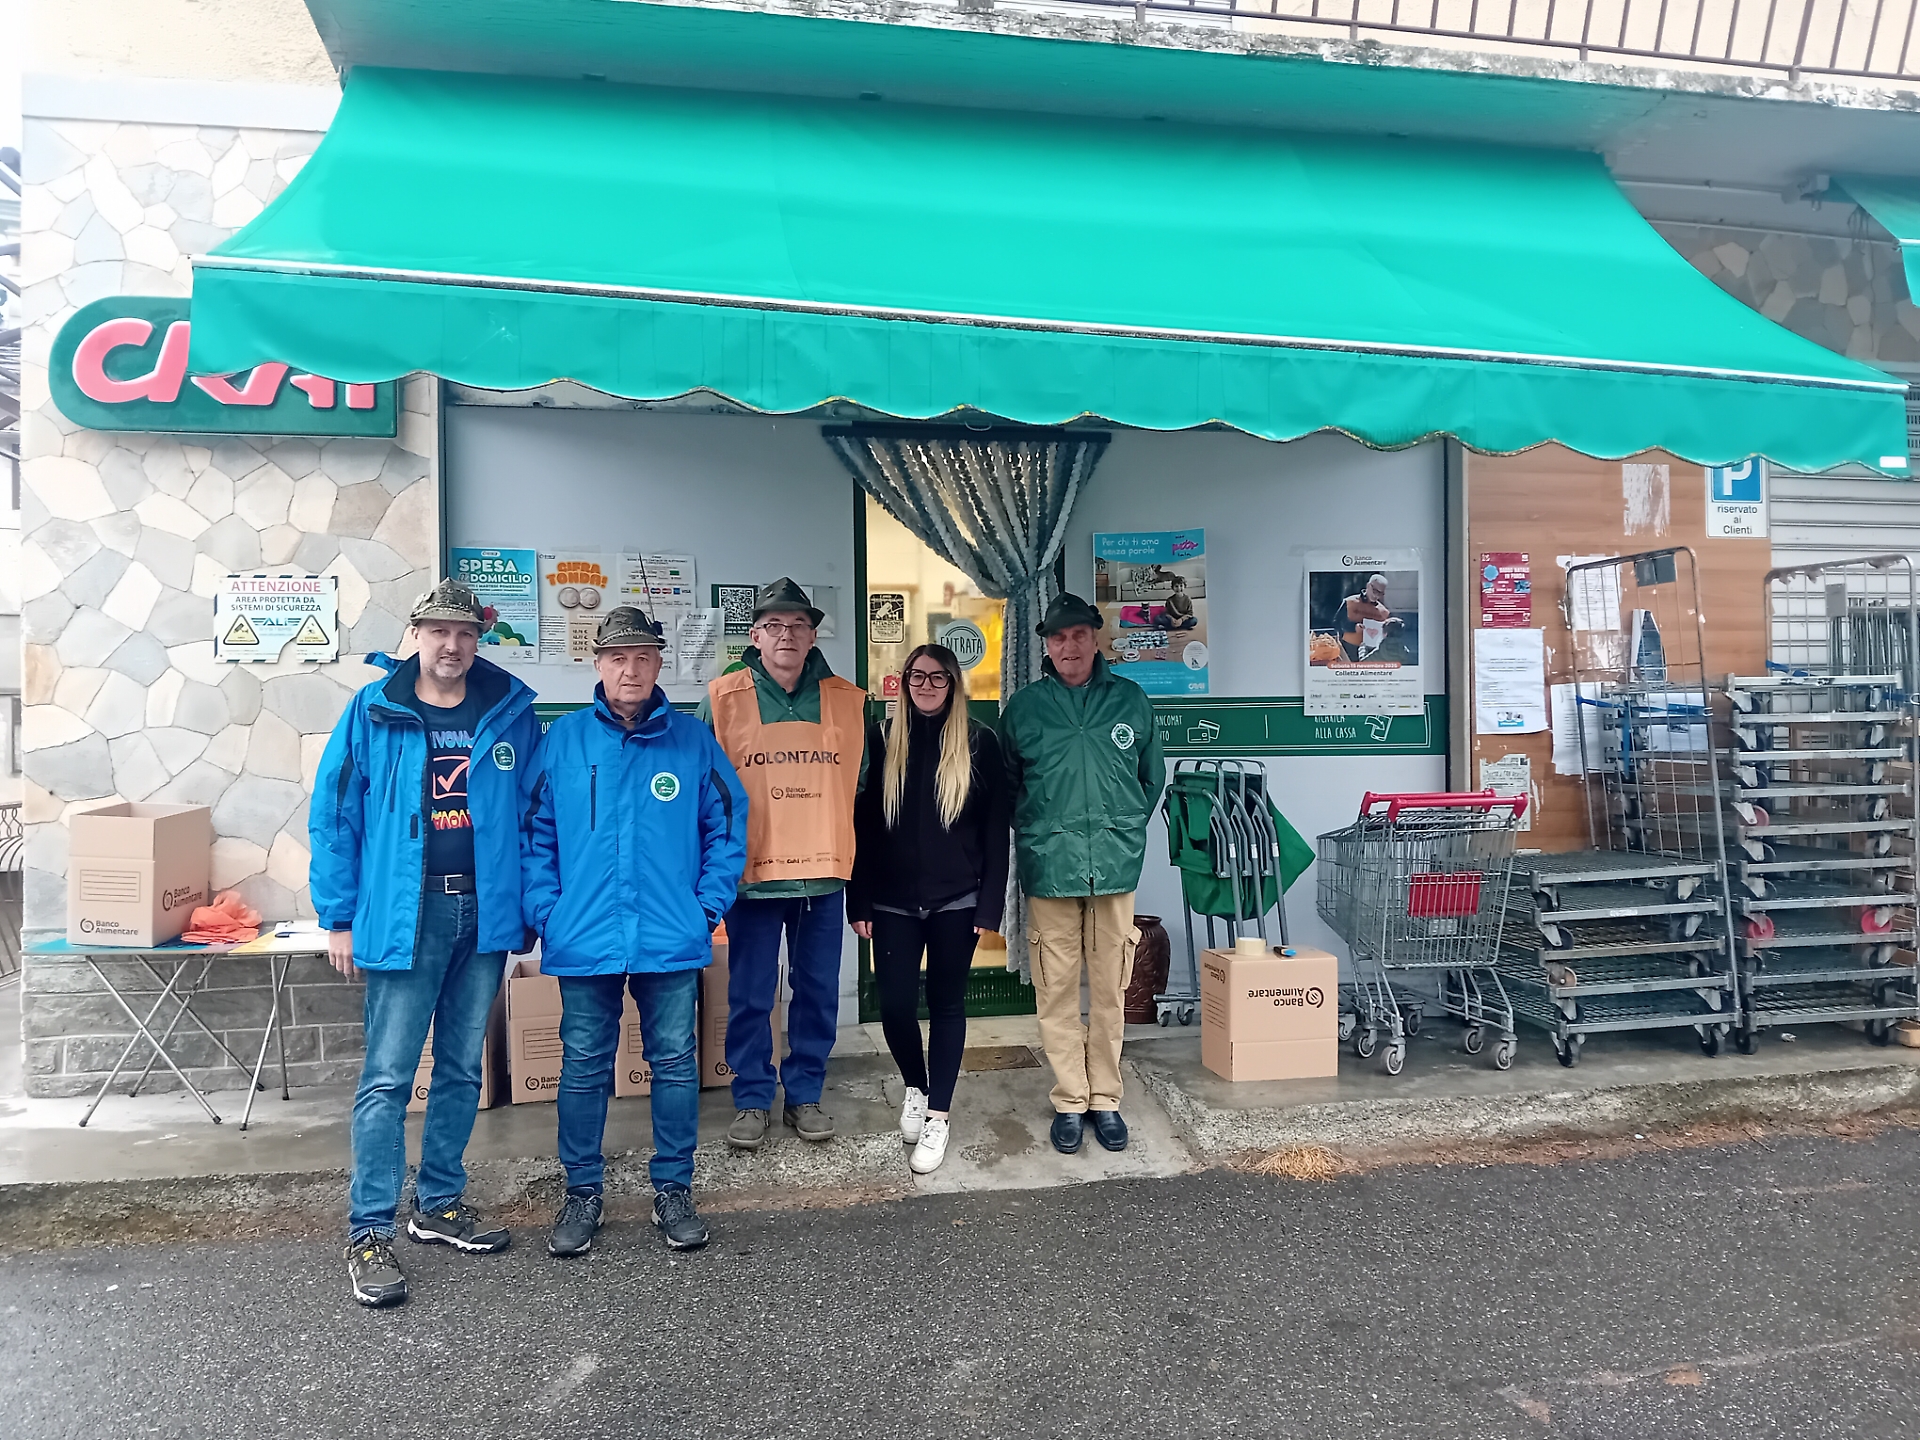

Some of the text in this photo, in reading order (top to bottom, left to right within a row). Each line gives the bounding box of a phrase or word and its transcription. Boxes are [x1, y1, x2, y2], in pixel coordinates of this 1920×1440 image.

[1723, 459, 1752, 496] P
[1717, 506, 1758, 514] riservato
[1733, 516, 1742, 524] ai
[1723, 525, 1752, 535] Clienti
[1102, 537, 1114, 546] Per
[1118, 536, 1128, 546] chi
[1132, 536, 1139, 546] ti
[1102, 545, 1155, 557] senza parole
[459, 559, 517, 573] SPESA
[557, 562, 600, 573] CIFRA
[470, 573, 532, 584] DOMICILIO
[546, 572, 608, 588] TONDA!
[231, 581, 321, 592] ATTENZIONE
[276, 604, 321, 612] SICUREZZA
[940, 636, 983, 654] ENTRATA
[1154, 714, 1182, 726] ANCOMAT
[1315, 727, 1357, 739] ALLA CASSA
[174, 886, 190, 898] Banco
[173, 891, 202, 908] Alimentare
[96, 920, 119, 928] Banco
[95, 928, 139, 936] Alimentare
[1248, 988, 1305, 998] Alimentare
[1273, 998, 1304, 1007] Banco
